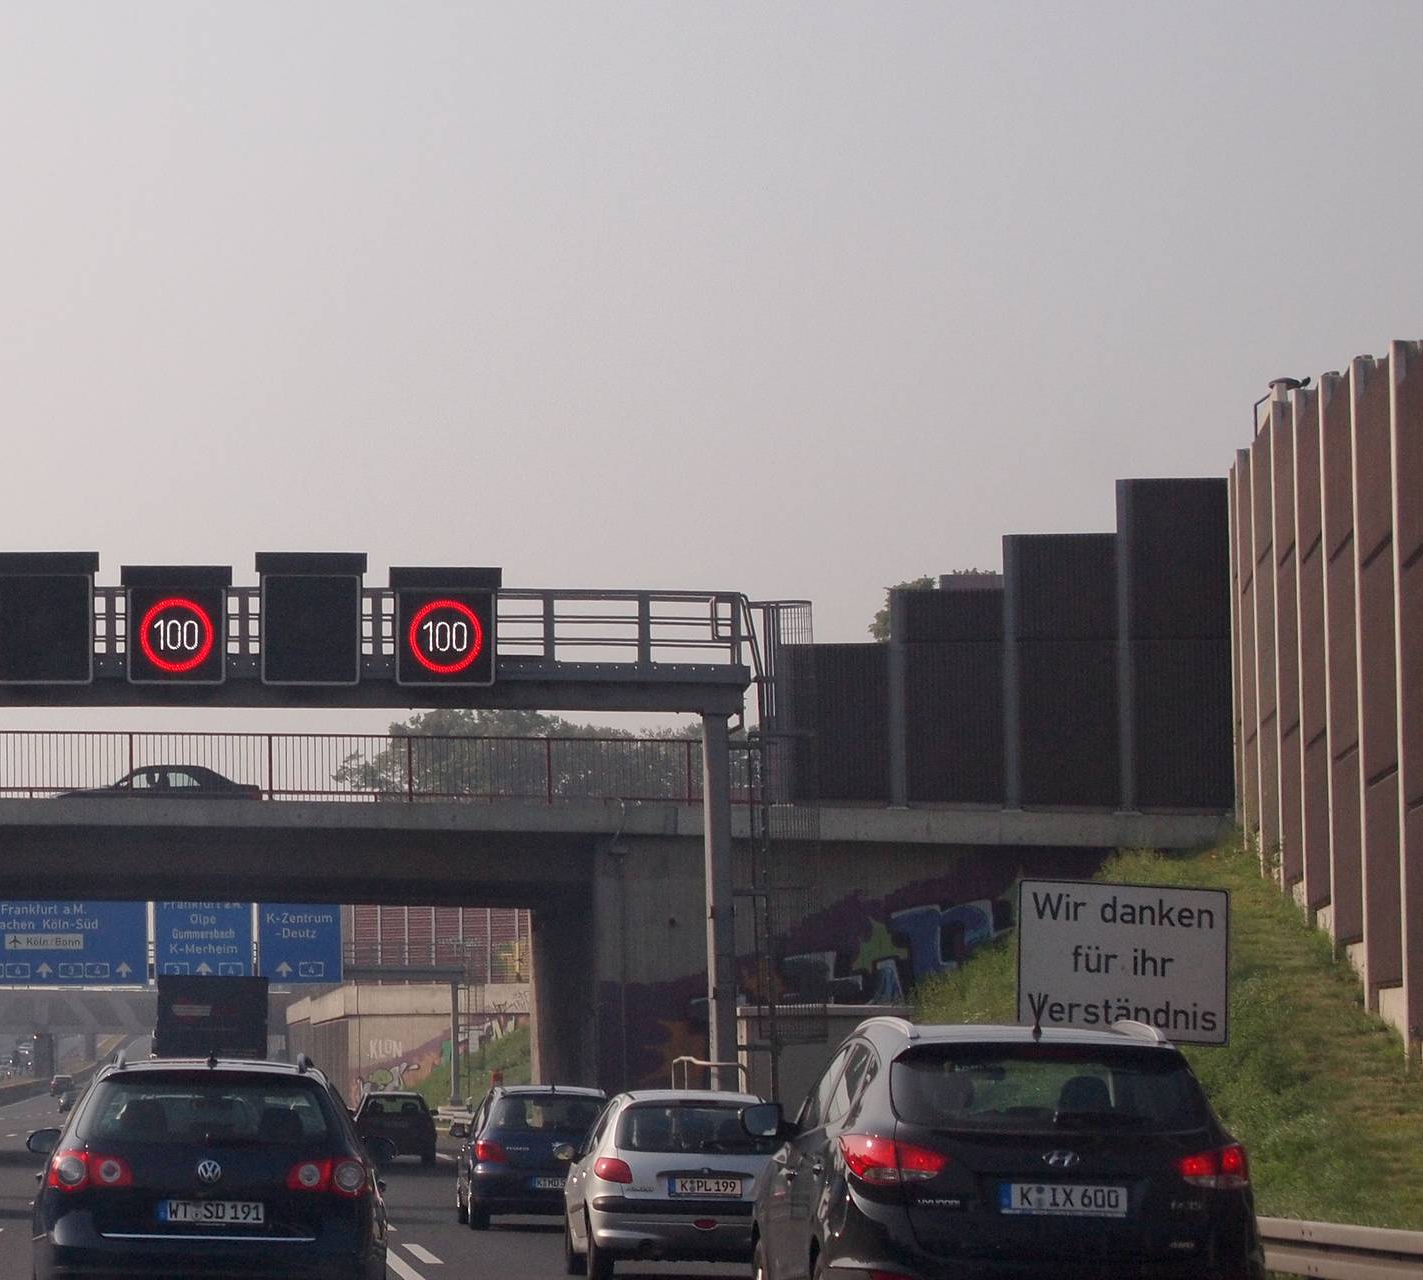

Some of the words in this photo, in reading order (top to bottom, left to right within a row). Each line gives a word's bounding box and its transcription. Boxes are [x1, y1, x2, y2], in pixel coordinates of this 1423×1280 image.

[154, 619, 198, 651] 100
[423, 620, 468, 652] 100
[1, 904, 58, 915] Frankfurt
[1032, 892, 1087, 922] Wir
[1100, 896, 1214, 929] danken
[42, 918, 99, 930] Köln-Süd
[190, 913, 217, 926] Olpe
[266, 913, 333, 924] K-Zentrum
[172, 928, 236, 940] Gummersbach
[169, 944, 238, 955] K-Merheim
[1073, 945, 1117, 974] für
[1133, 949, 1174, 977] ihr
[1028, 993, 1217, 1033] Verständnis
[681, 1180, 688, 1192] K
[697, 1181, 711, 1192] PL
[715, 1181, 736, 1192] 199
[1020, 1187, 1032, 1206] K
[1050, 1188, 1074, 1207] IX
[1080, 1189, 1118, 1208] 600
[169, 1202, 190, 1218] WT
[203, 1203, 225, 1219] SD
[230, 1204, 261, 1220] 191
